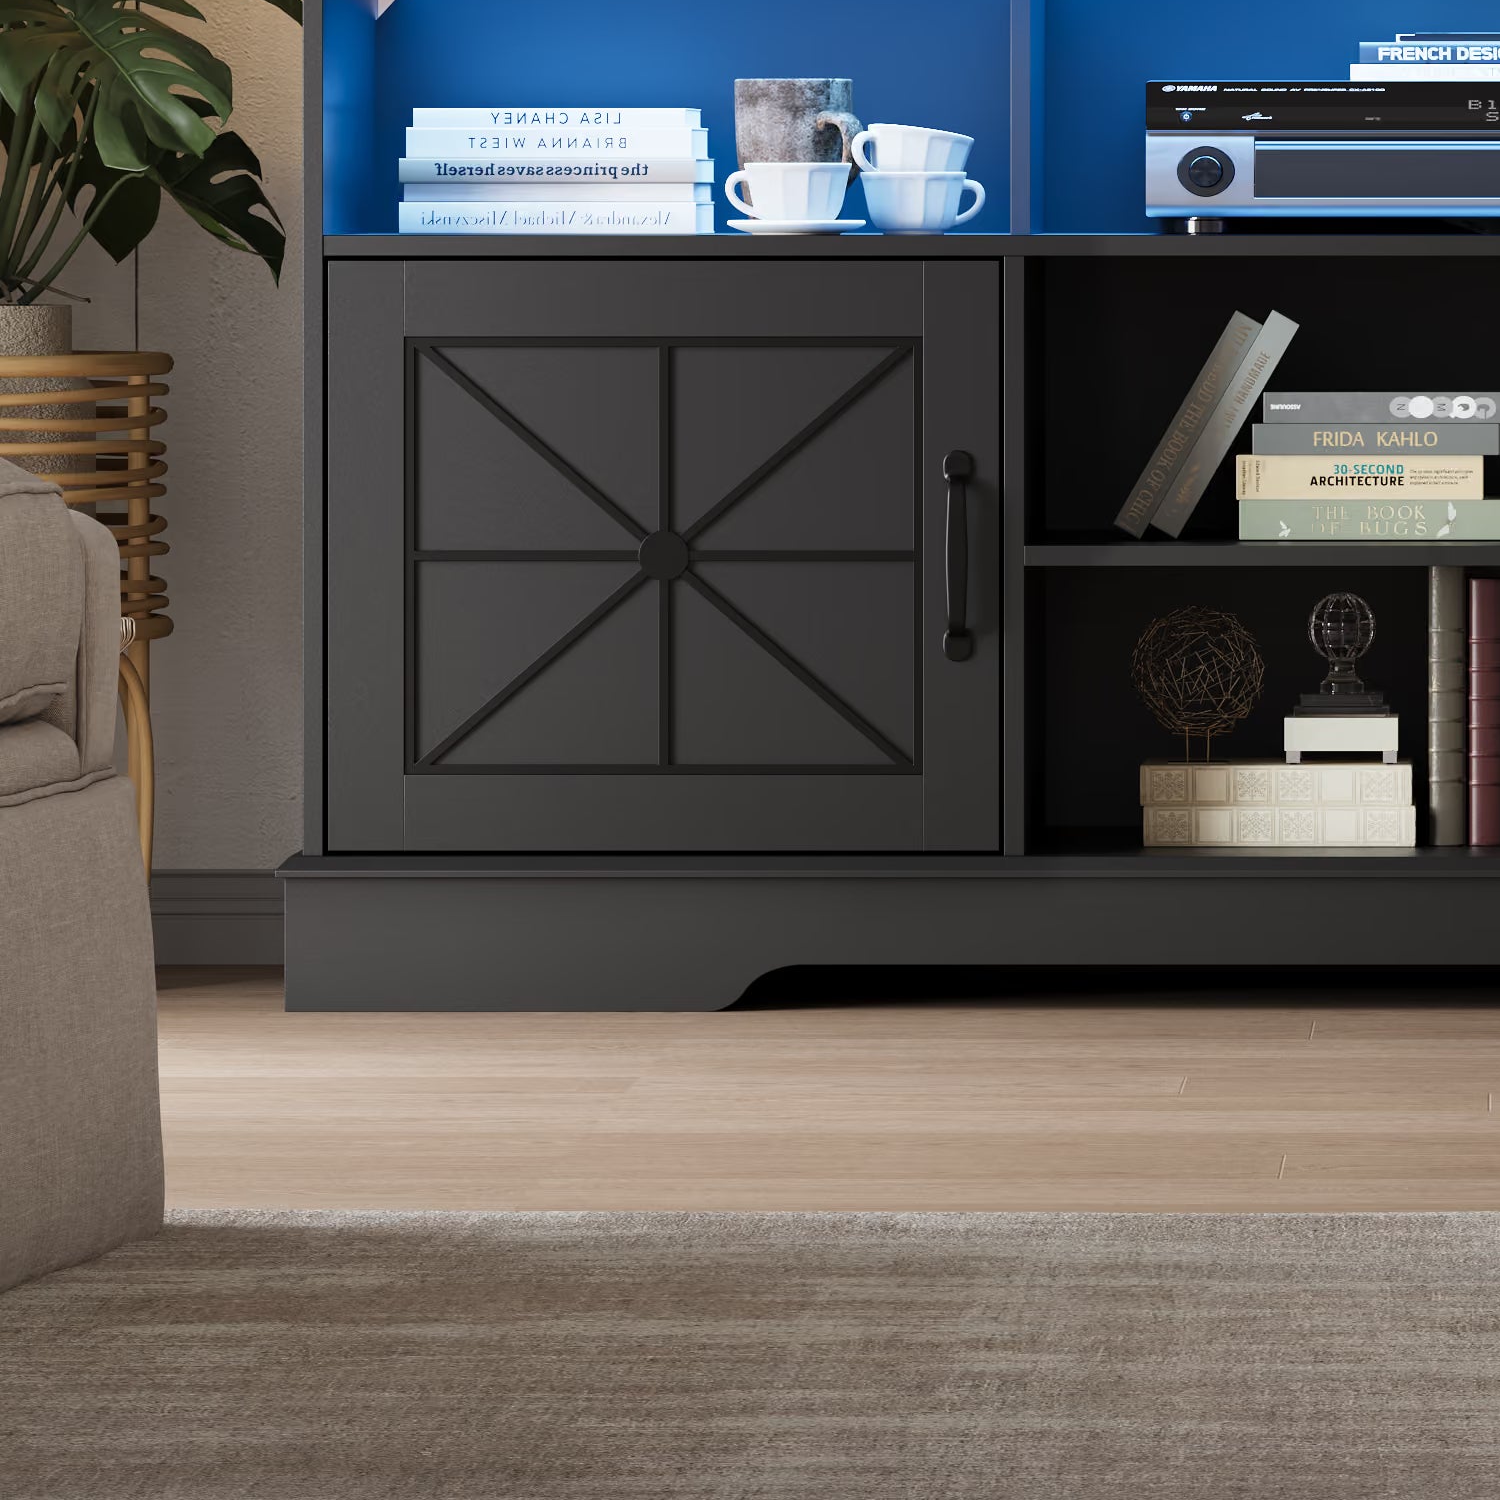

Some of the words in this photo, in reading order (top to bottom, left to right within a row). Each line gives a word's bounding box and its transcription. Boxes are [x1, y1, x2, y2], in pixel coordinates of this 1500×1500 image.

[1378, 46, 1451, 62] FRENCH
[1313, 431, 1365, 447] FRIDA
[1377, 431, 1438, 447] KAHLO
[1162, 430, 1189, 468] BOOK
[1333, 464, 1404, 475] 30-SECOND
[1310, 476, 1404, 486] ARCHITECTURE
[1127, 489, 1154, 524] CHIC
[1312, 505, 1350, 520] THE
[1367, 505, 1426, 520] BOOK
[1311, 521, 1342, 536] OF
[1360, 521, 1428, 536] BUGS
